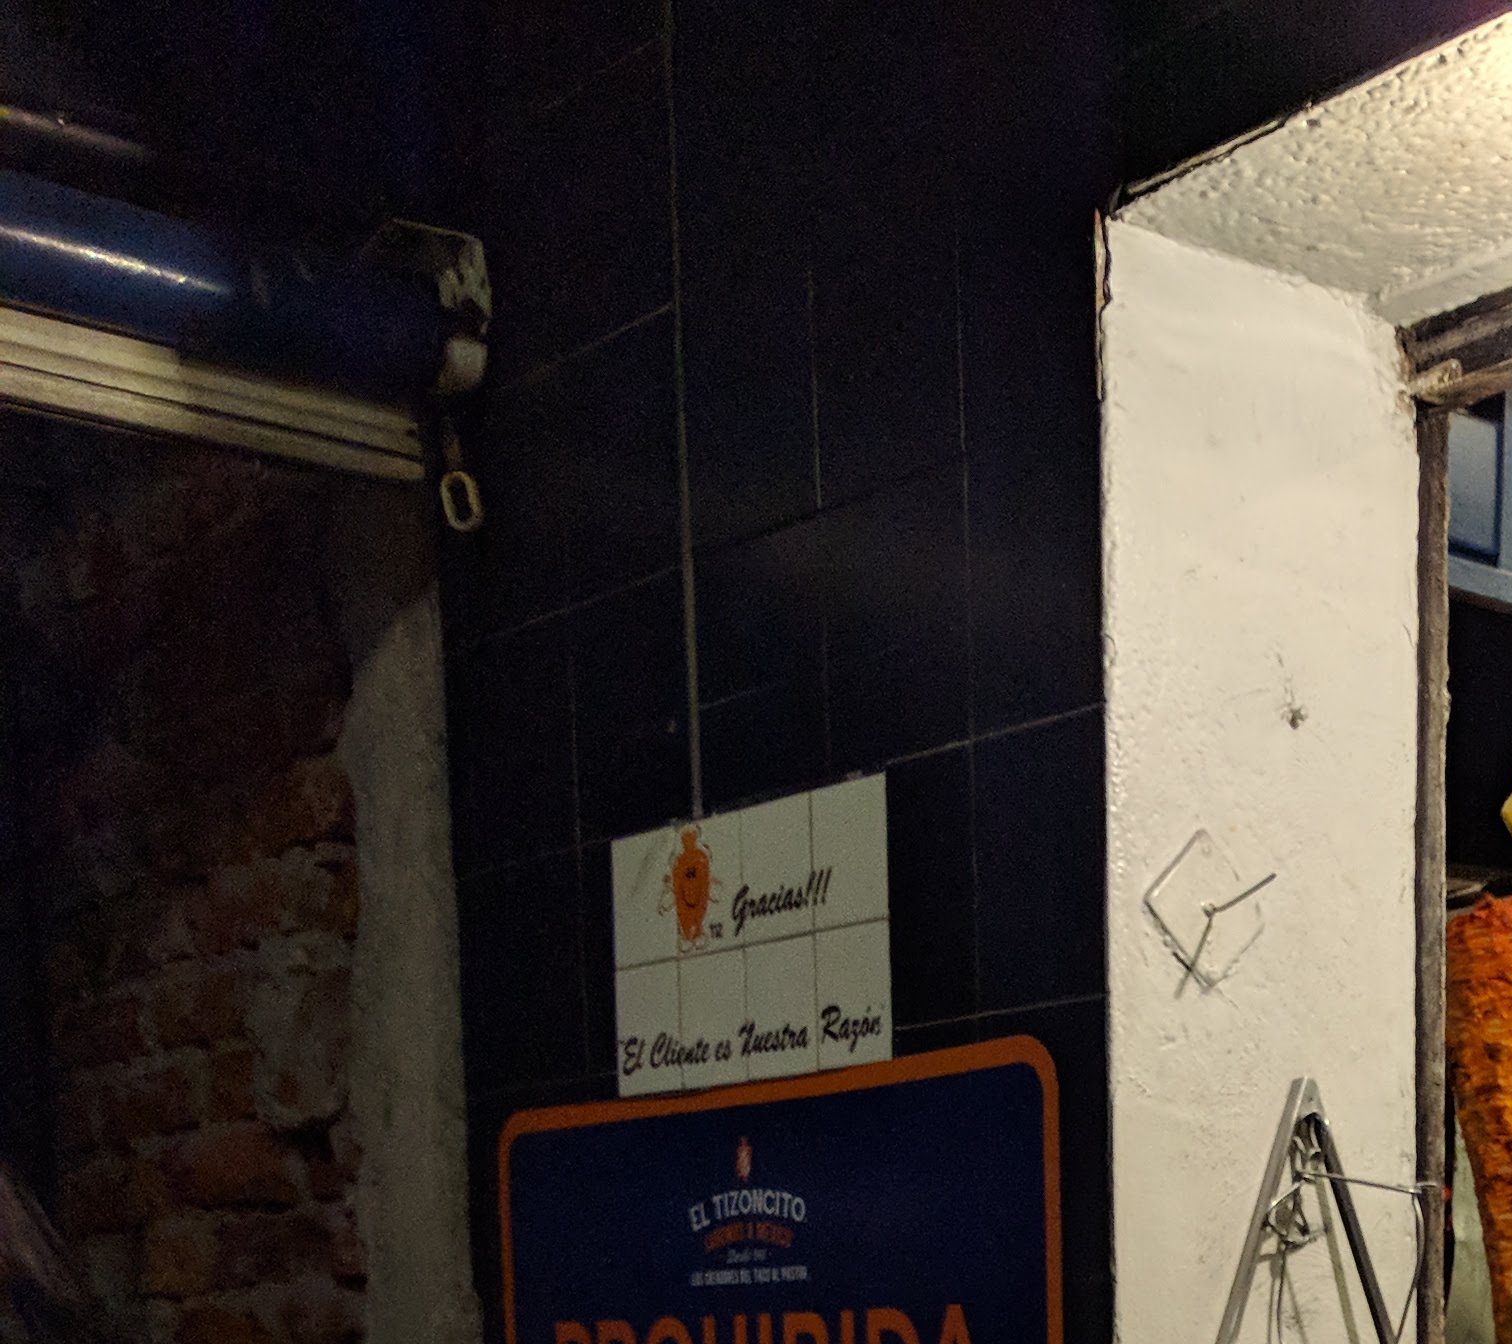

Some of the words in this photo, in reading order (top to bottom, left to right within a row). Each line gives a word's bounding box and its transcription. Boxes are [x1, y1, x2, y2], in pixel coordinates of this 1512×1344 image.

[731, 866, 832, 937] Gracias!!!
[650, 1032, 711, 1068] Cliente
[714, 1039, 732, 1061] es
[737, 1021, 809, 1058] Nuestra
[688, 1202, 711, 1232] EL
[711, 1189, 807, 1223] TIZONCITO
